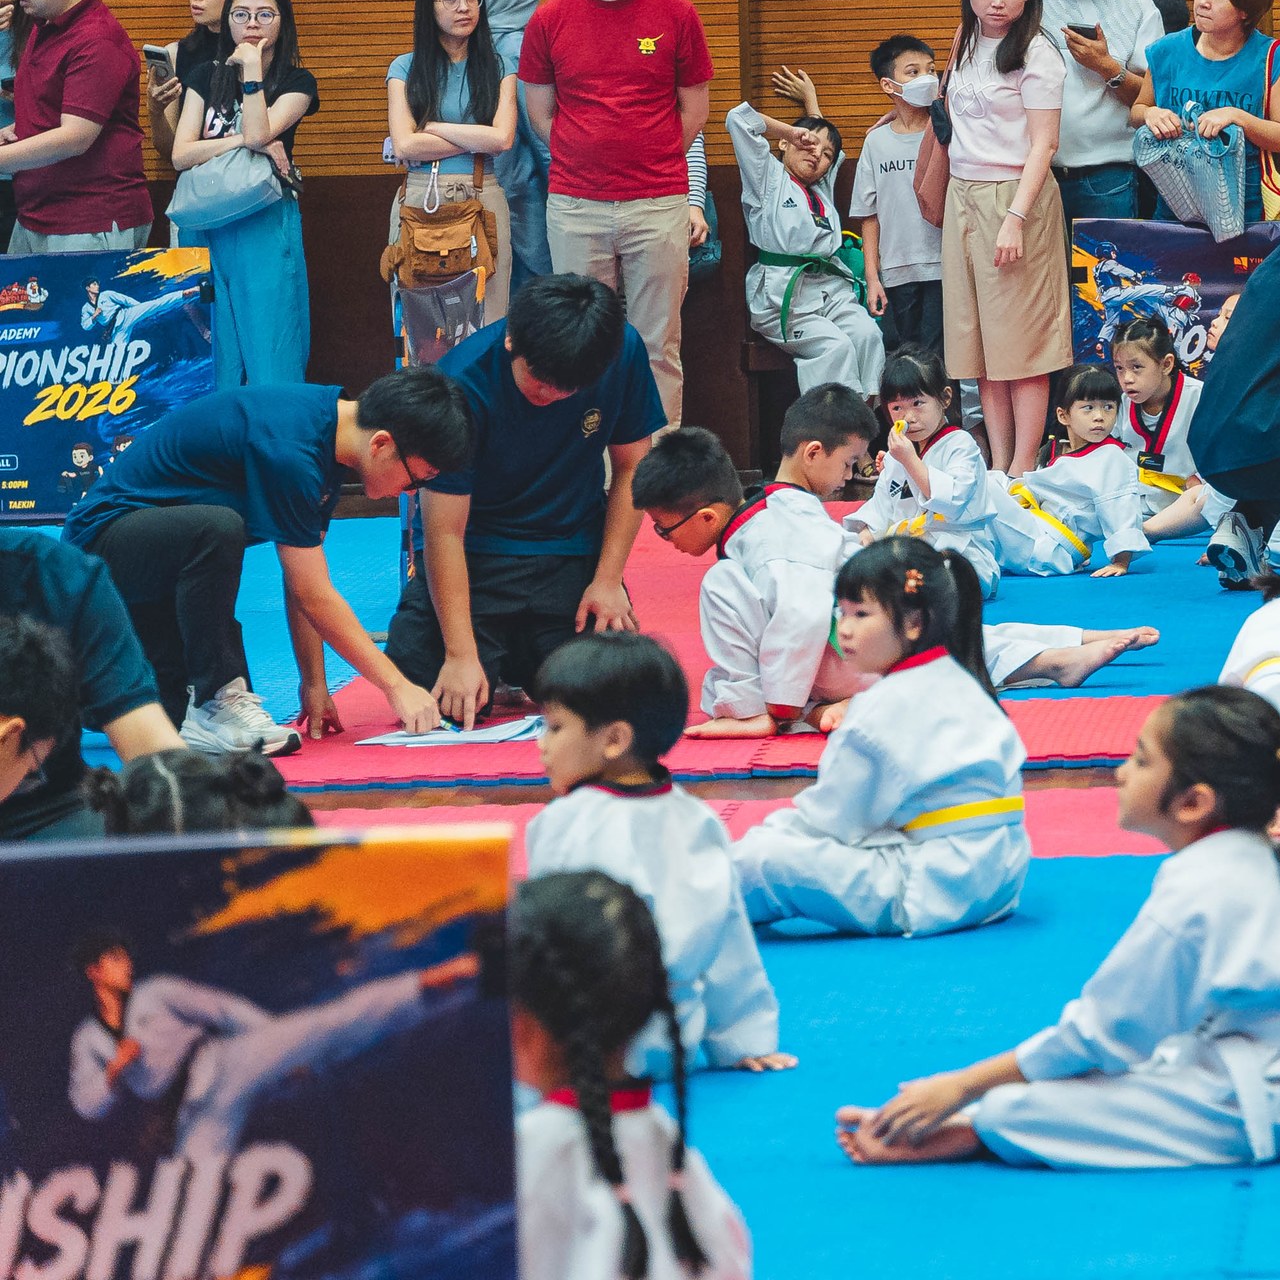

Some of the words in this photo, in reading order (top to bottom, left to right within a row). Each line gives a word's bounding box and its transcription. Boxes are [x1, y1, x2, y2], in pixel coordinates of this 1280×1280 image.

[1170, 86, 1254, 109] ROWING
[879, 159, 916, 174] NAUT
[0, 326, 41, 341] ADEMY
[23, 374, 141, 427] 2026
